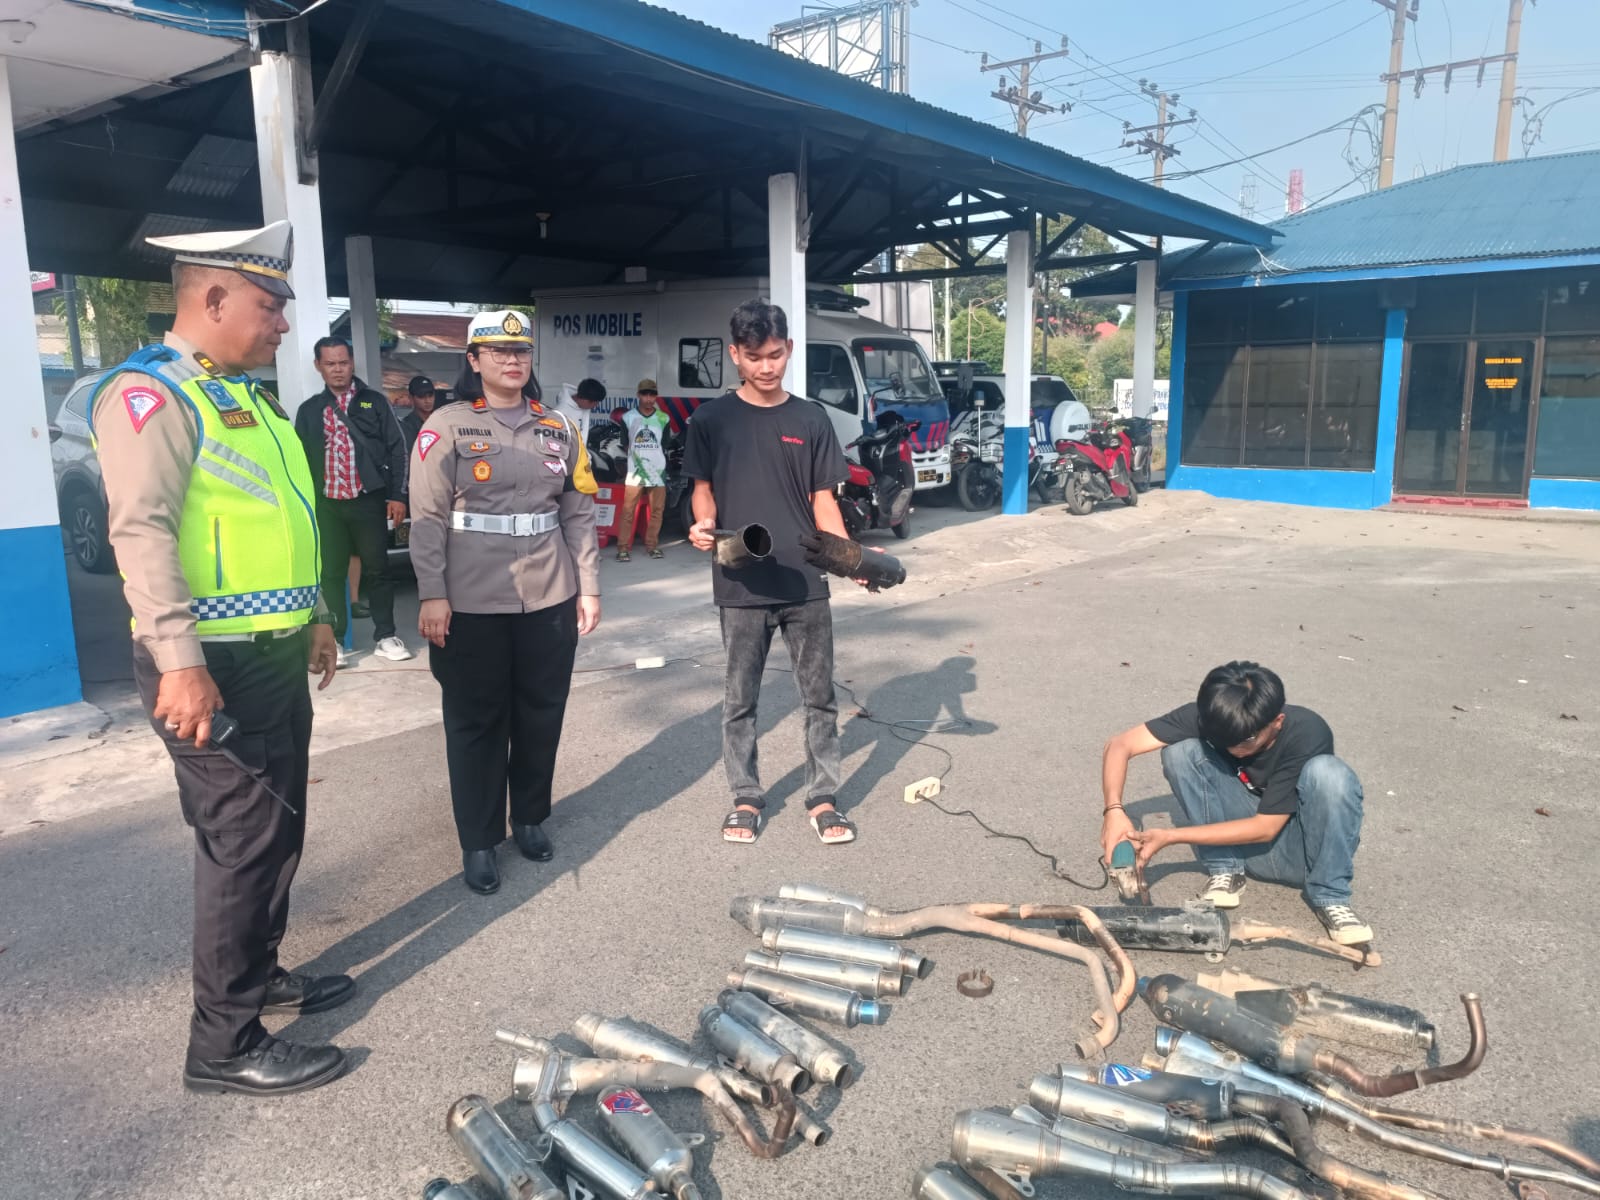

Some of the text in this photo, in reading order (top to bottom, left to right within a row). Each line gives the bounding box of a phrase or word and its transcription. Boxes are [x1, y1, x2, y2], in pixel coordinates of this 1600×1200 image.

[554, 312, 642, 337] POS MOBILE
[534, 428, 568, 443] POLRI
